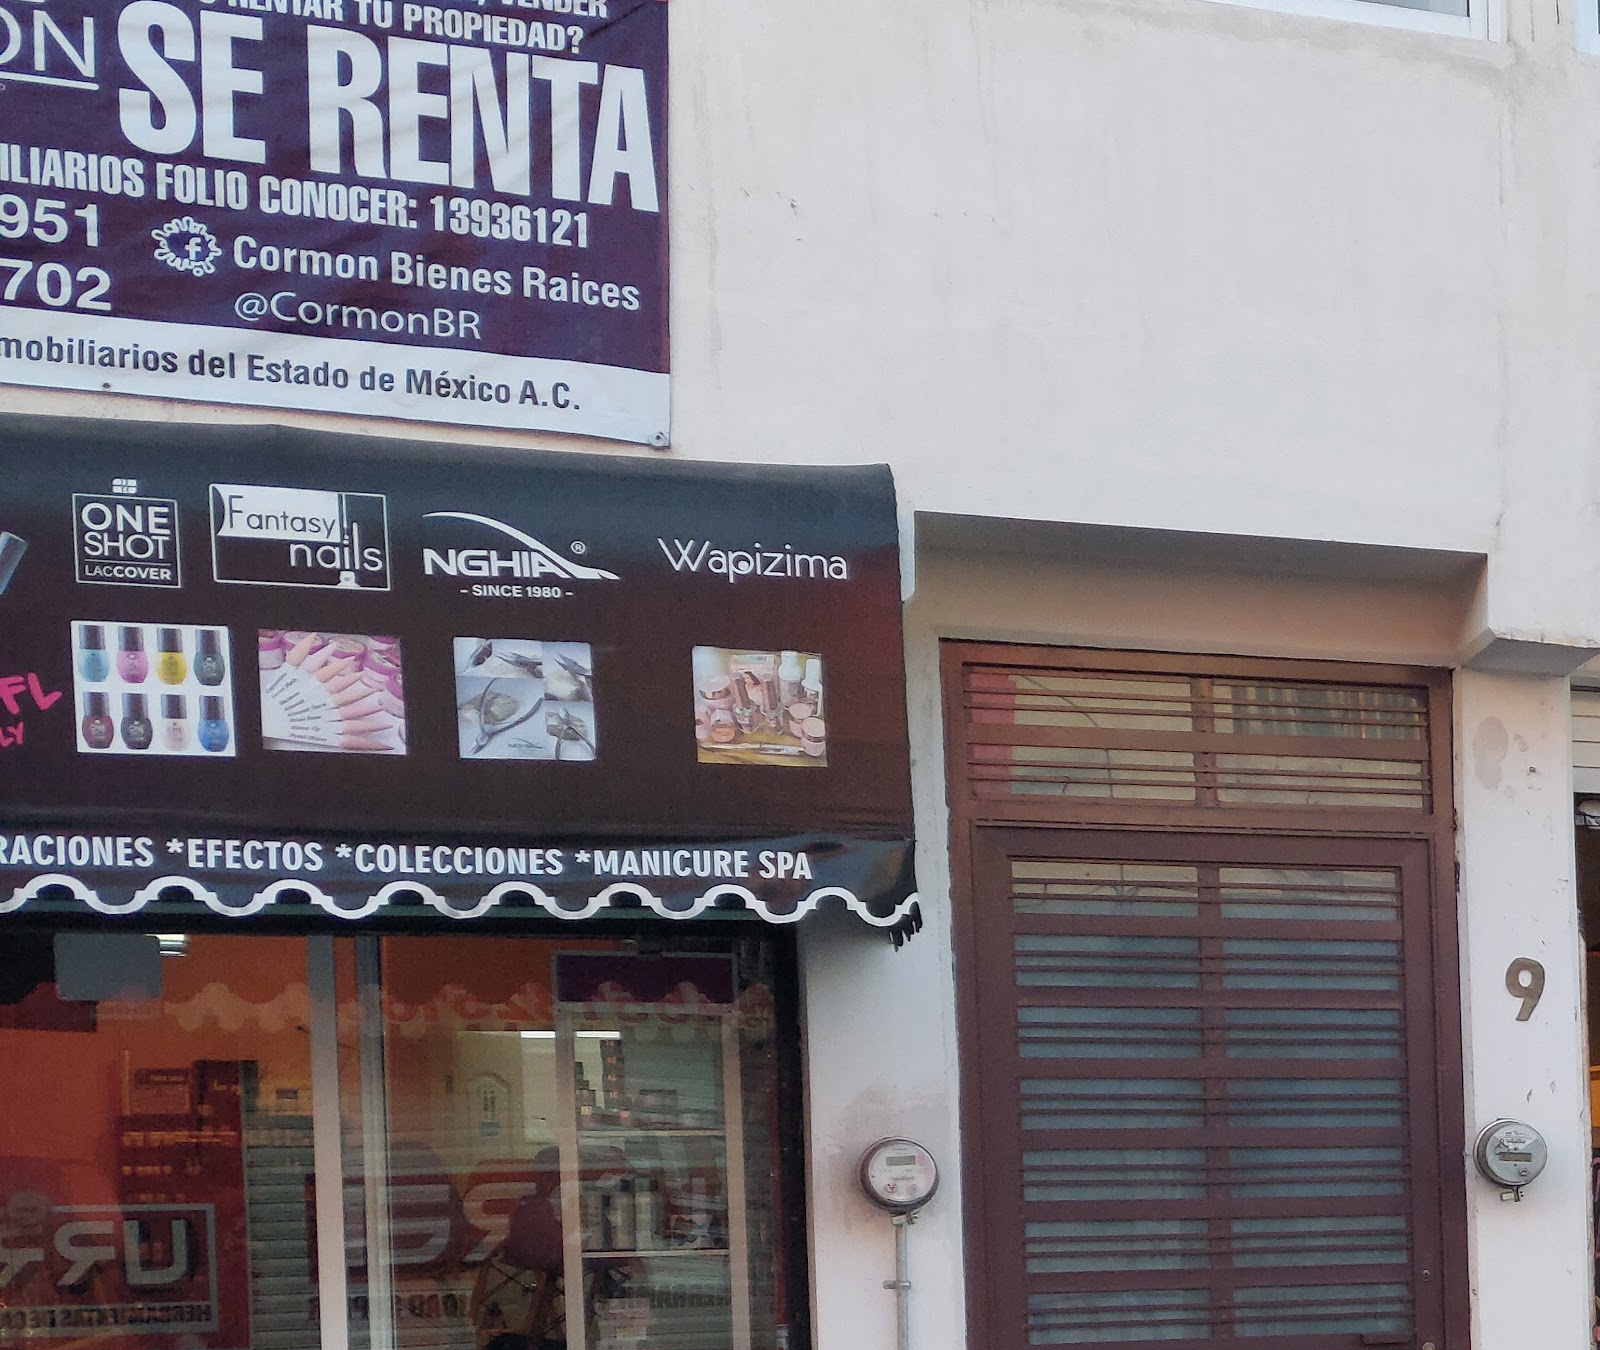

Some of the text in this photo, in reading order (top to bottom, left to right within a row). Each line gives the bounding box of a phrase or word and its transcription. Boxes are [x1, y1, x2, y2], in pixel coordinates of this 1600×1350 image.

[356, 0, 393, 28] TU
[403, 3, 584, 53] PROPIEDAD?
[117, 0, 659, 213] SE RENTA
[0, 193, 99, 248] 951
[156, 162, 248, 212] FOLIO
[260, 178, 418, 229] CONOCER:
[430, 196, 588, 248] 13936121
[0, 258, 112, 311] 702
[234, 236, 640, 311] Cormon Bienes Raices
[233, 291, 481, 340] @CormonBR
[188, 347, 236, 380] del
[247, 354, 349, 390] Estado
[359, 362, 394, 393] de
[405, 367, 511, 405] México
[519, 381, 580, 411] A.C.
[81, 502, 171, 535] ONE
[228, 495, 337, 538] Fantasy
[84, 533, 169, 560] SHOT
[290, 521, 384, 572] nails
[422, 549, 571, 579] NGHIA
[659, 537, 849, 582] Wapizima
[84, 563, 172, 581] LACCOVER
[472, 584, 562, 598] SINCE 1980
[0, 835, 154, 867] RACIONES
[759, 852, 813, 881] SPA
[1506, 957, 1545, 1021] 9
